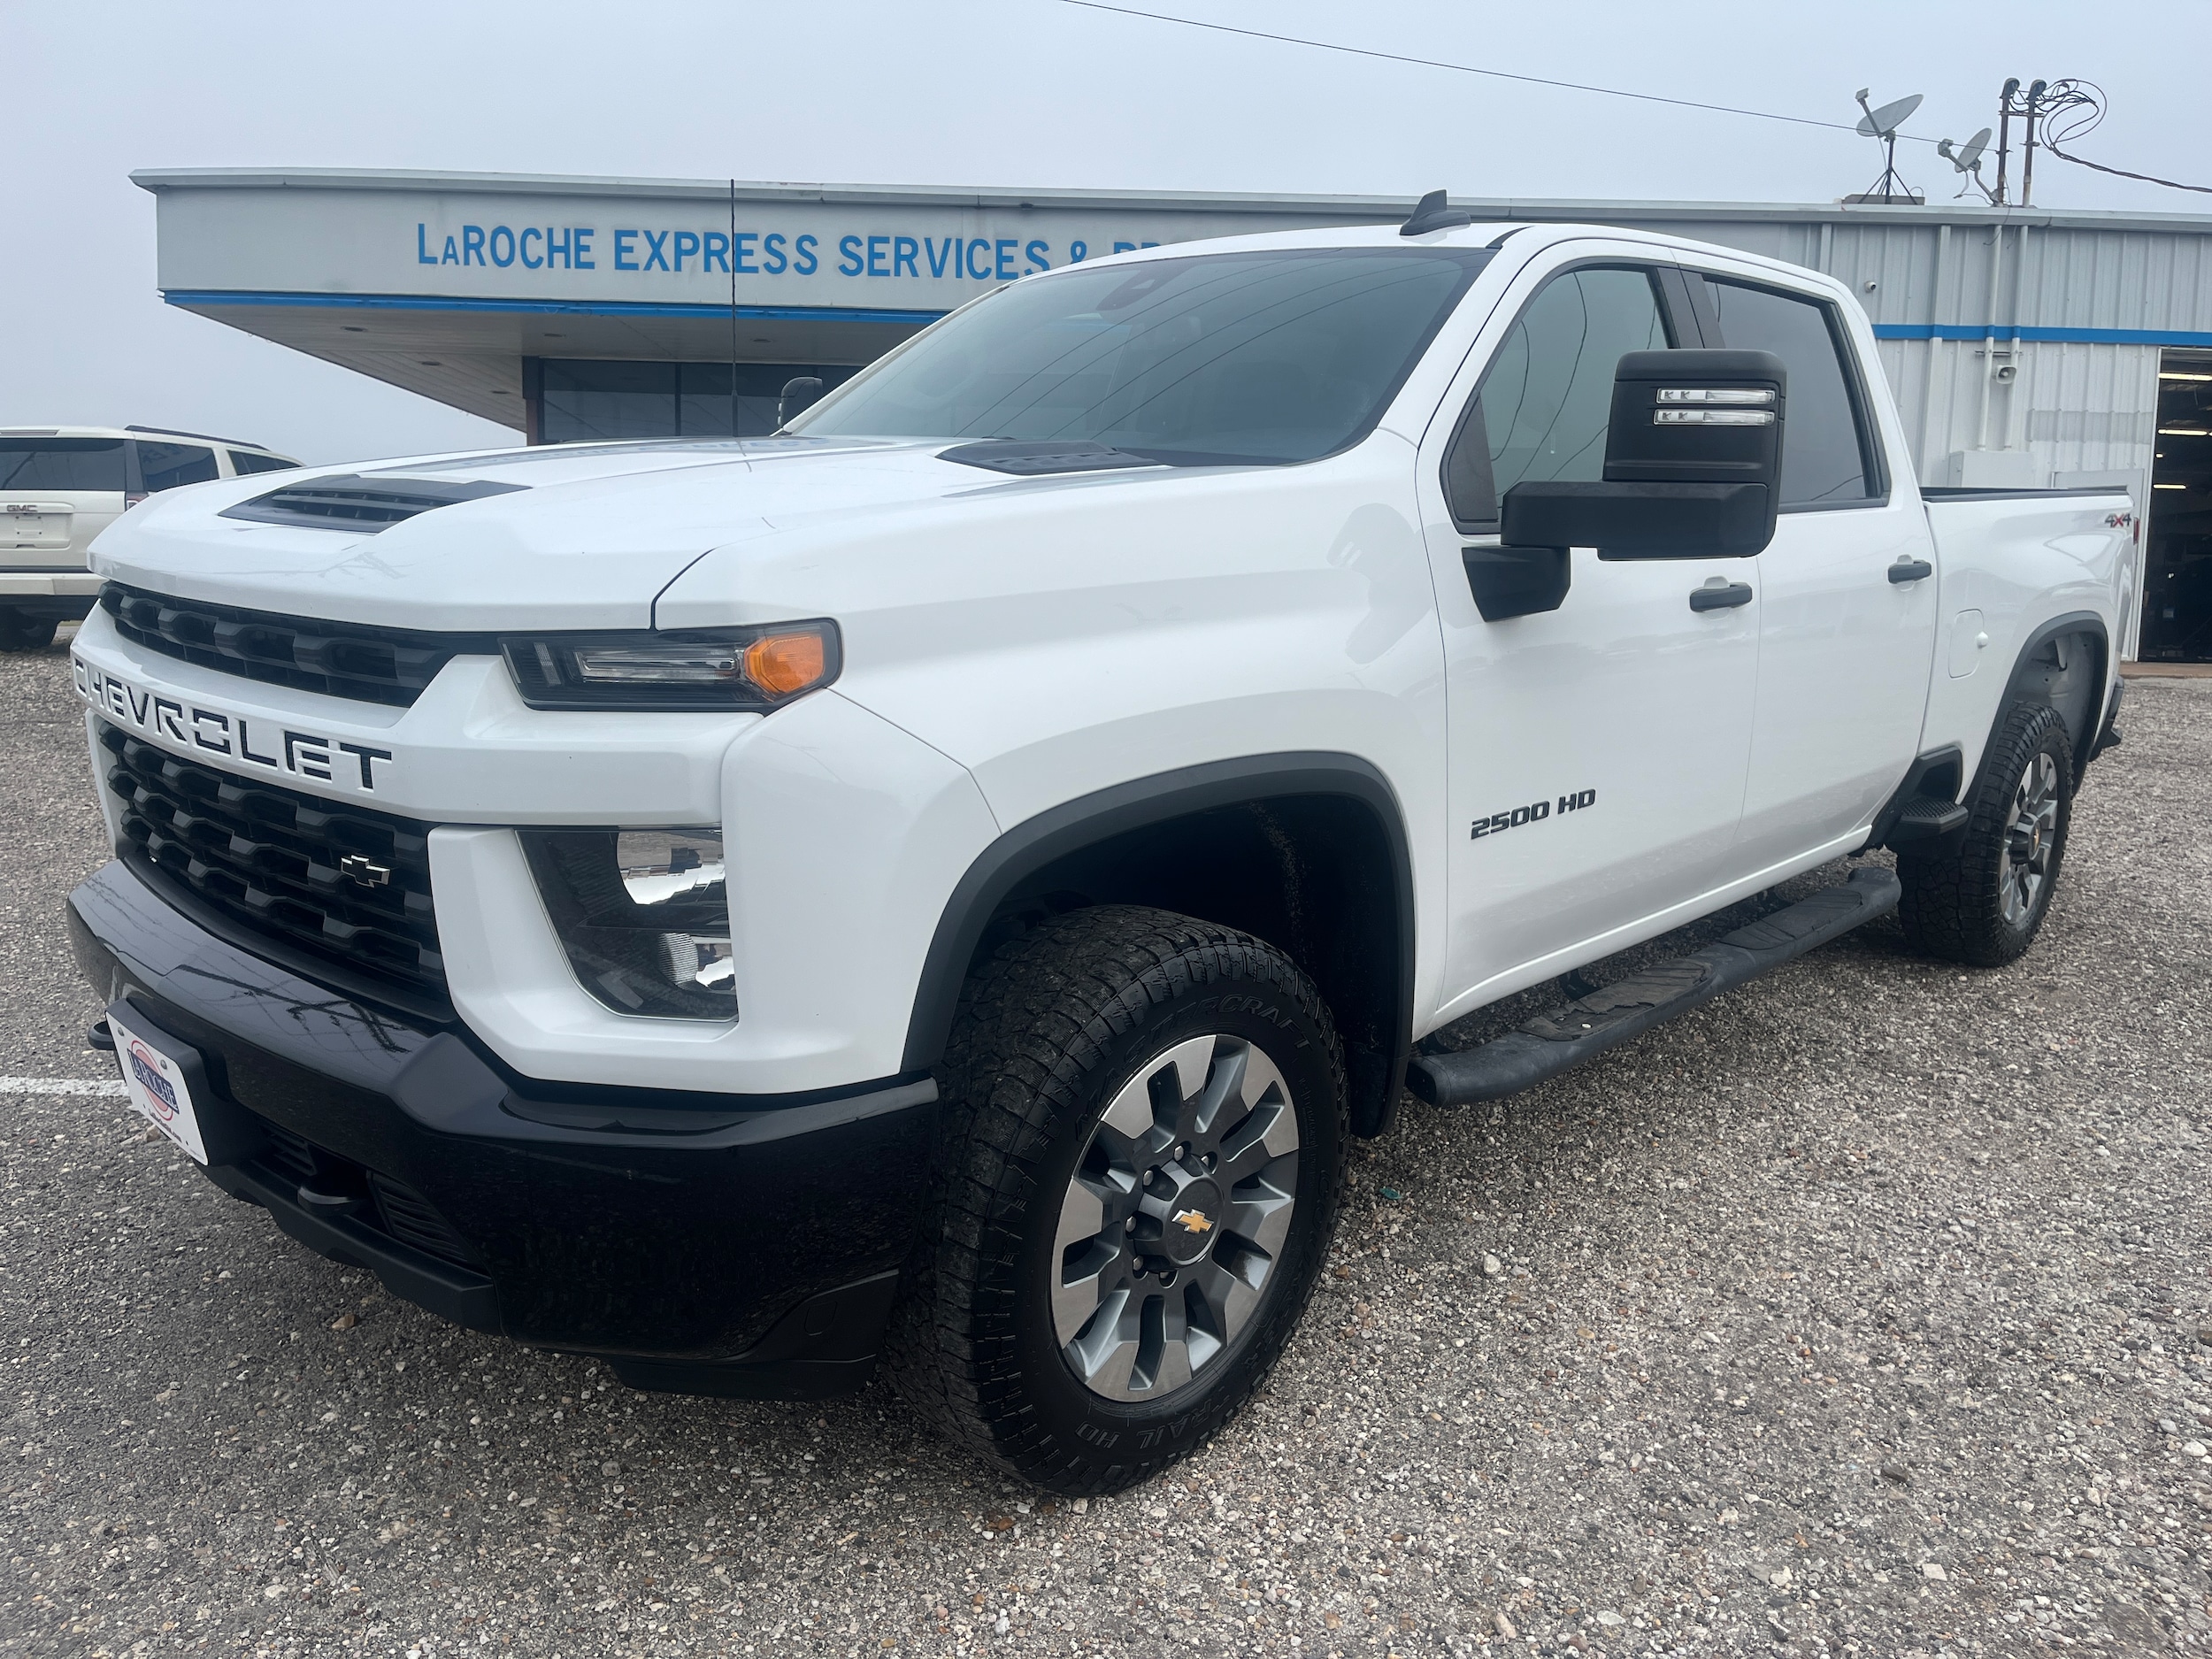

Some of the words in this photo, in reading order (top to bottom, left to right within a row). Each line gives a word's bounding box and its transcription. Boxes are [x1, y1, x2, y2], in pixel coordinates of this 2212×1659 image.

[612, 229, 819, 276] EXPRESS
[838, 234, 1051, 281] SERVICES
[73, 657, 393, 790] CHEVROLET
[1471, 800, 1550, 840] 2500
[1557, 788, 1596, 815] HD
[1074, 994, 1314, 1141] MASTERCRAFT
[1074, 1420, 1122, 1449] HD
[1136, 1386, 1231, 1449] TRAIL
